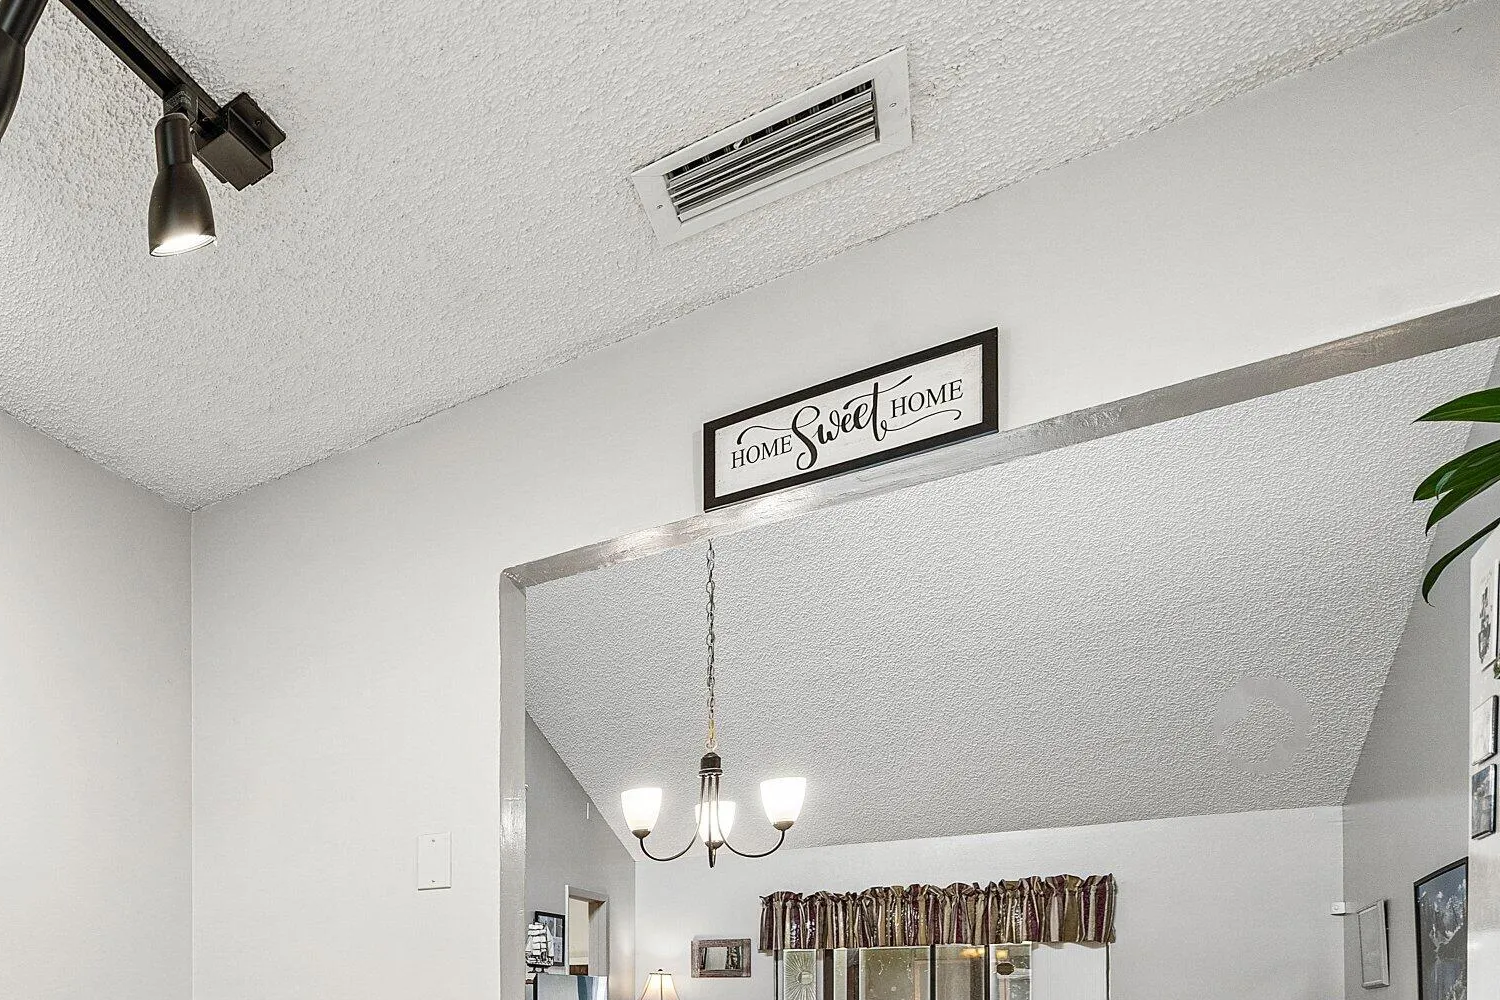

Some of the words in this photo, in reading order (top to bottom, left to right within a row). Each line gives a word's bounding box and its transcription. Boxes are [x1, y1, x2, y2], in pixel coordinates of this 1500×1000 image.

[731, 434, 793, 469] HOME
[791, 376, 912, 470] Sweet
[891, 379, 964, 418] HOME
